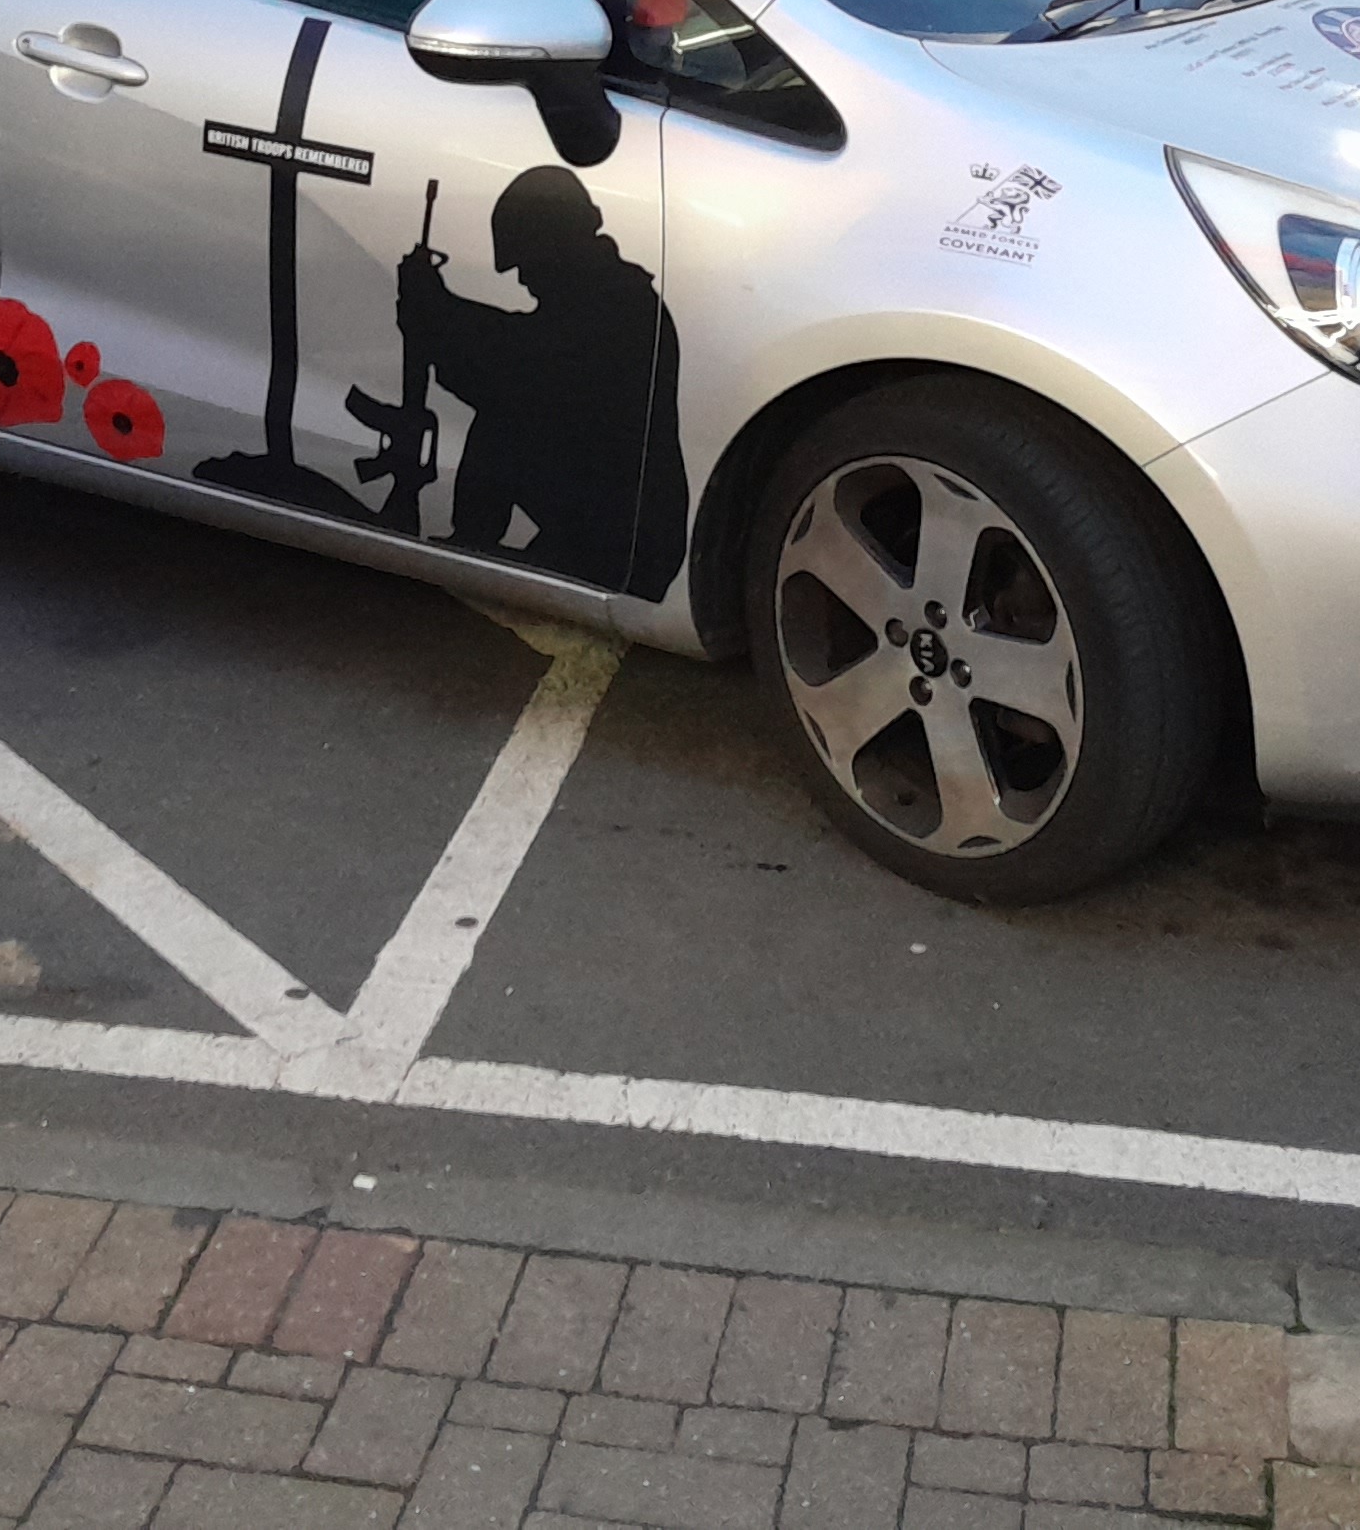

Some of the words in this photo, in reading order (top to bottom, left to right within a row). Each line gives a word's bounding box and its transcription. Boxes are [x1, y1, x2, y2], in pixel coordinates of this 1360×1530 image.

[207, 129, 249, 151] BRITISH
[251, 137, 293, 160] TROOPS
[294, 146, 370, 176] REMEMBERED
[939, 236, 1035, 263] COVENANT
[920, 633, 935, 673] KIA
